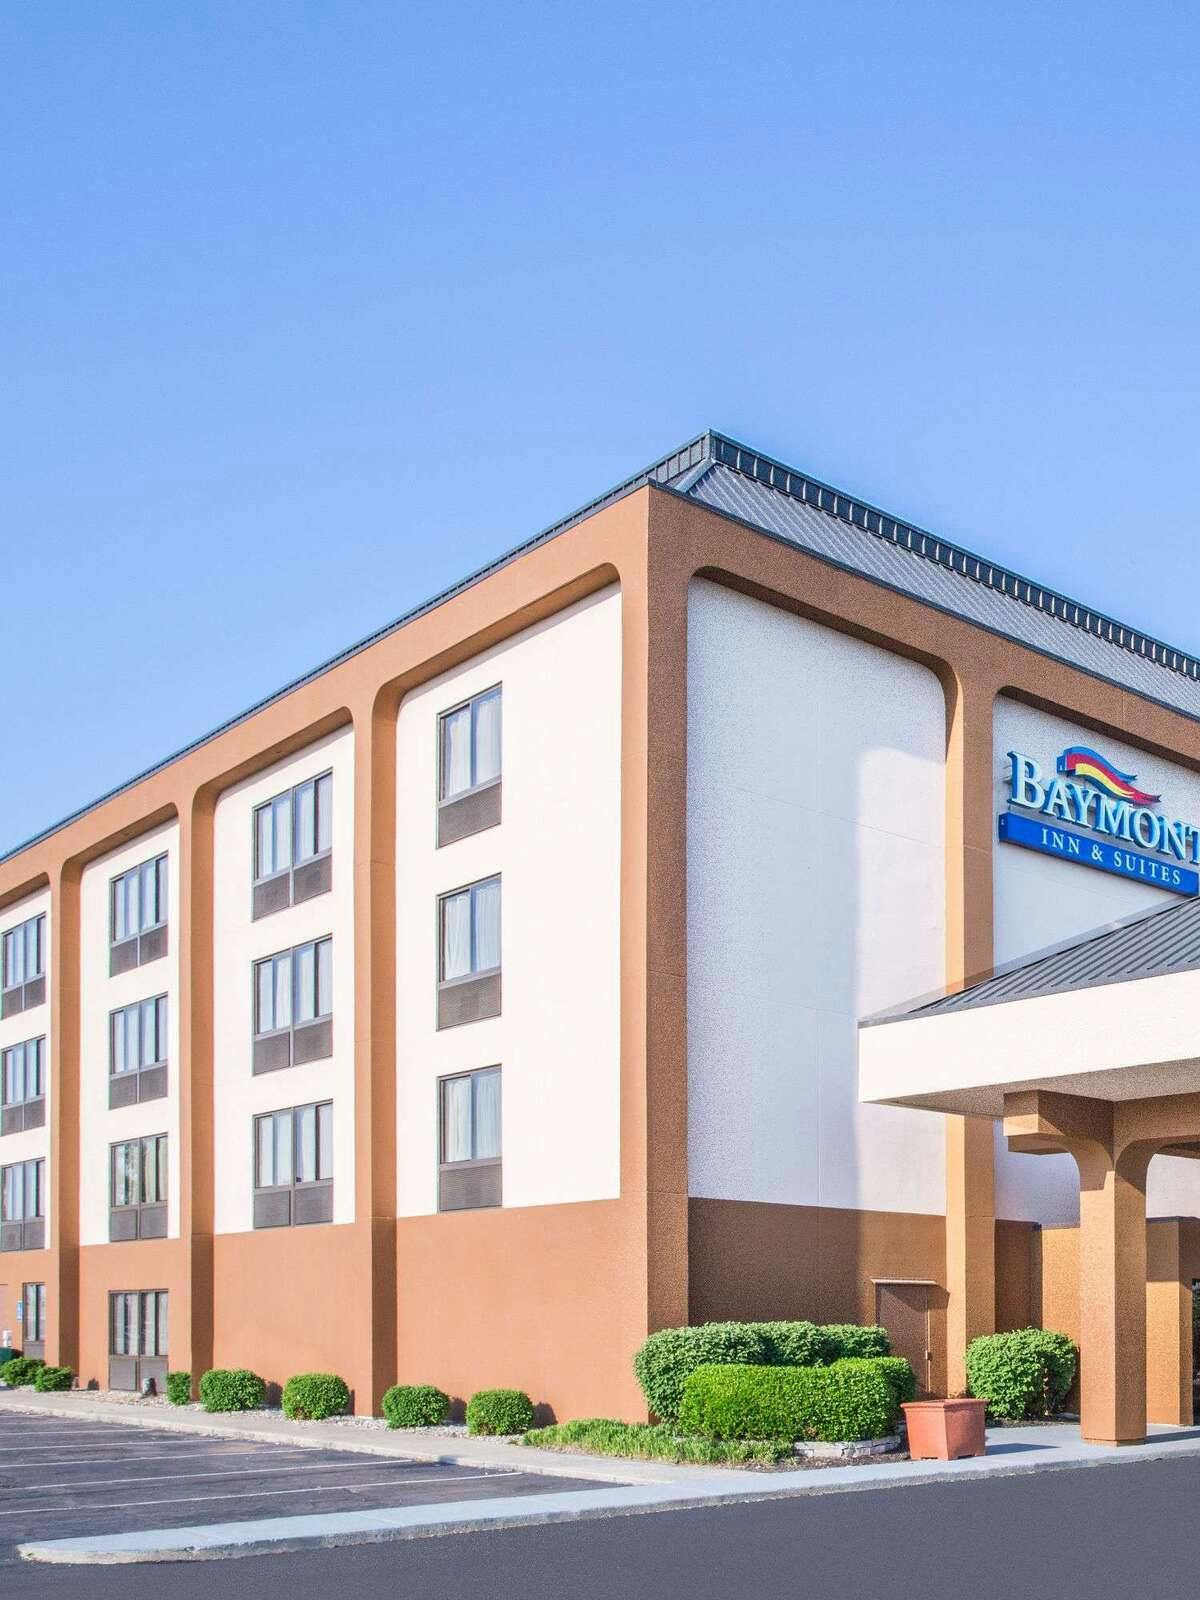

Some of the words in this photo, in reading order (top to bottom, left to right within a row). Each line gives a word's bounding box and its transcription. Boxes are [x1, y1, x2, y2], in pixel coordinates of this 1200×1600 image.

[1042, 828, 1081, 854] INN
[1091, 844, 1104, 862] &
[1114, 851, 1181, 885] SUITES
